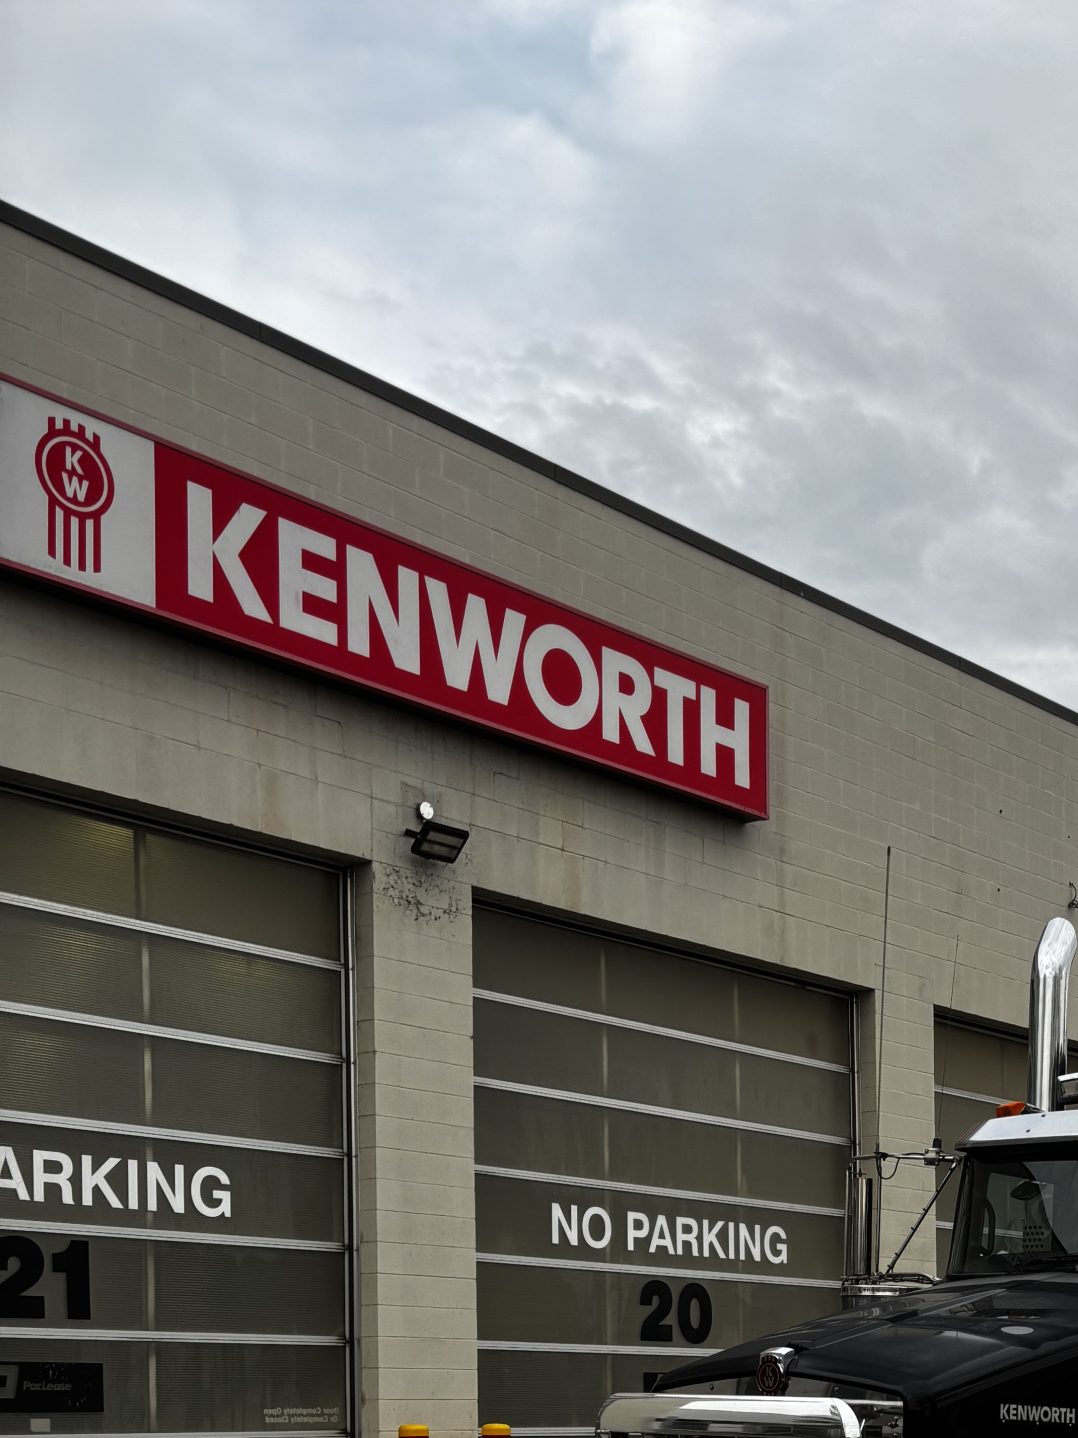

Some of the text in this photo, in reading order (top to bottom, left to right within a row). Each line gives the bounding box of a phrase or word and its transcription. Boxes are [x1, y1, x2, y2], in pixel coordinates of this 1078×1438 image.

[65, 445, 85, 476] K
[61, 471, 89, 503] W
[187, 480, 750, 790] KENWORTH
[551, 1202, 788, 1265] NO PARKING
[0, 1235, 91, 1320] 21
[639, 1279, 713, 1345] 20
[23, 1380, 72, 1391] PacLease
[999, 1403, 1076, 1424] KENWORTH
